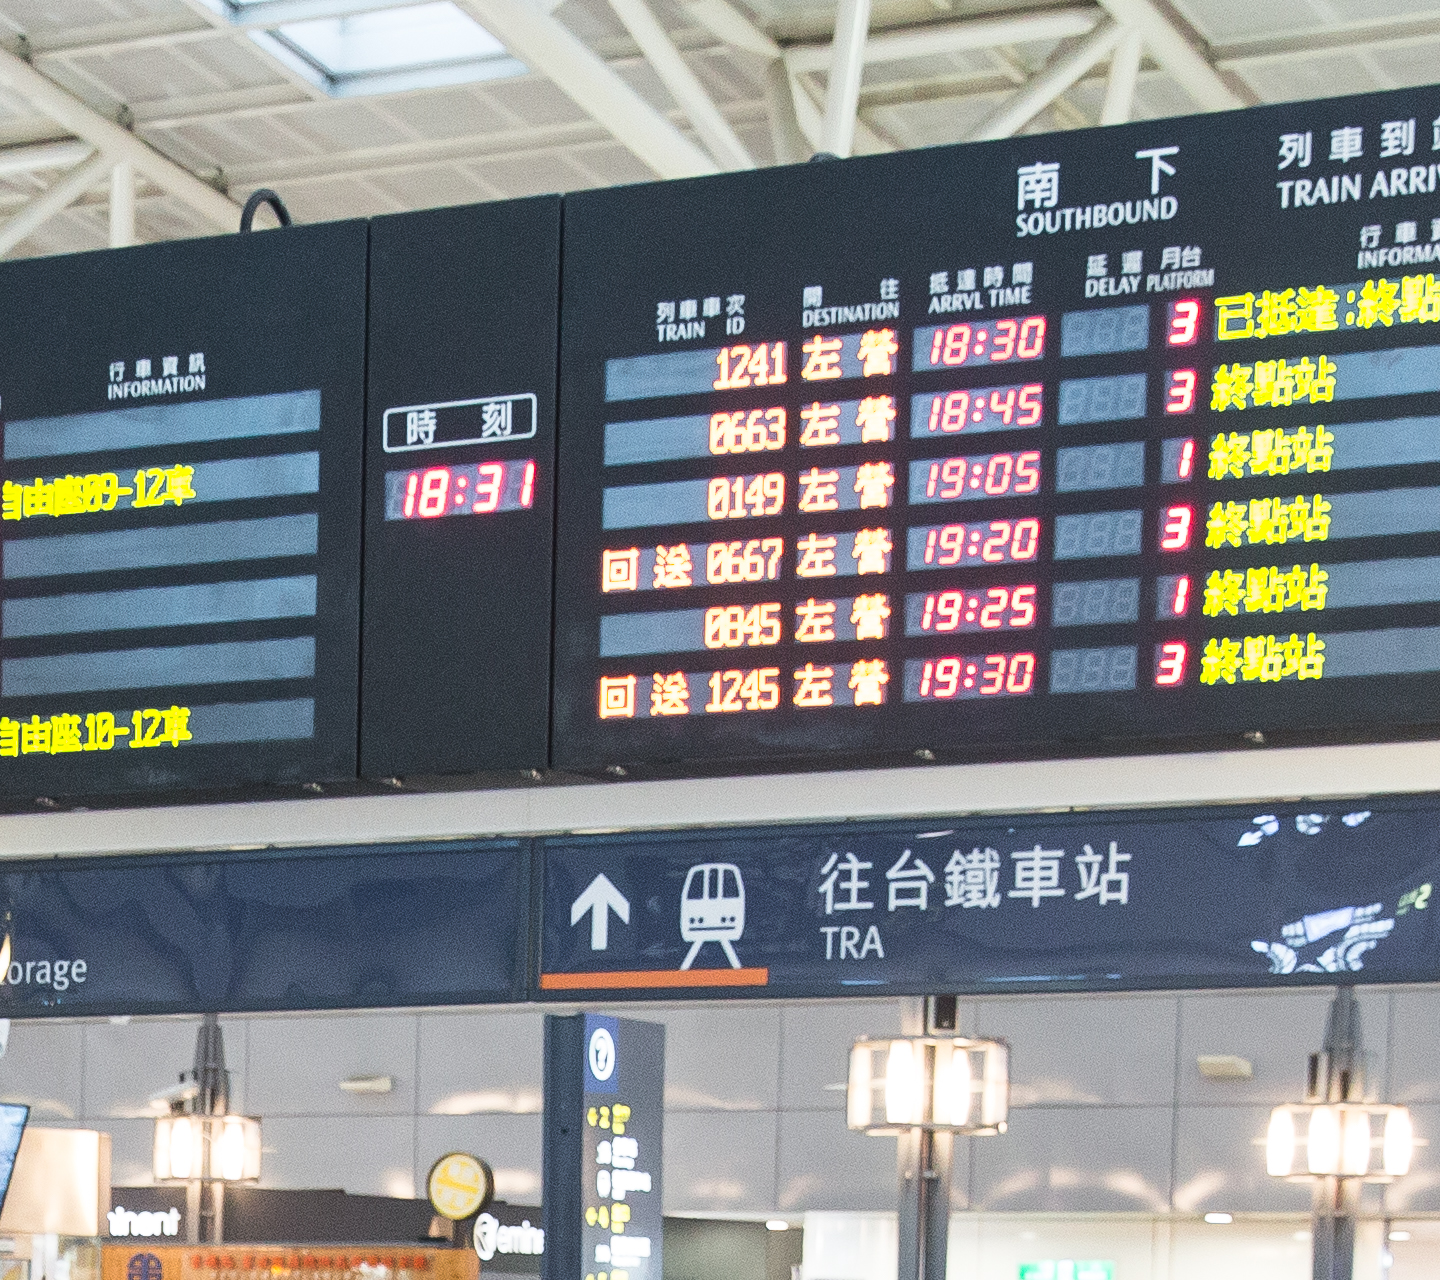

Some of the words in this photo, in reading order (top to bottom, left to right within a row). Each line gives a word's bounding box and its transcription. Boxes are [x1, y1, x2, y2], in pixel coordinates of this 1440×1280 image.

[1017, 146, 1180, 208] 南下
[1277, 173, 1365, 209] TRAIN
[1016, 196, 1179, 238] SOUTHBOUND
[1161, 246, 1202, 271] 月台
[929, 292, 983, 315] ARRVL
[990, 286, 1031, 308] TIME
[1085, 274, 1141, 299] DELAY
[1147, 268, 1214, 293] PLATFORM
[657, 320, 705, 342] TRAIN
[726, 316, 745, 336] ID
[802, 301, 900, 328] DESTINATION
[713, 341, 788, 390] 1241
[801, 328, 899, 382] 左營
[930, 316, 1046, 366] 18:30
[1168, 299, 1200, 345] 3
[108, 374, 206, 400] INFORMATION
[709, 407, 787, 455] 0663
[799, 395, 897, 447] 左營
[928, 383, 1044, 432] 18:45
[1166, 369, 1197, 413] 3
[1211, 355, 1337, 412] 終點站
[407, 401, 513, 446] 時刻
[403, 459, 537, 518] 18:31
[708, 472, 785, 520] 0149
[798, 461, 895, 512] 左營
[926, 452, 1041, 499] 19:05
[1178, 440, 1195, 478] 1
[1208, 425, 1335, 480] 終點站
[602, 543, 693, 592] 回送
[706, 538, 784, 584] 0667
[796, 527, 893, 578] 左營
[924, 518, 1040, 565] 19:20
[1161, 506, 1193, 550] 3
[1205, 494, 1332, 549] 終點站
[704, 603, 782, 649] 0845
[794, 593, 891, 643] 左營
[921, 585, 1037, 631] 19:25
[1173, 576, 1190, 615] 1
[1203, 563, 1328, 616] 終點站
[599, 671, 691, 719] 回送
[705, 667, 781, 713] 1245
[793, 658, 890, 707] 左營
[920, 653, 1036, 698] 19:30
[1156, 642, 1187, 685] 3
[1200, 632, 1325, 685] 終點站
[819, 841, 1132, 917] 往台鐵車站
[820, 924, 883, 961] TRA
[107, 1205, 181, 1236] inent
